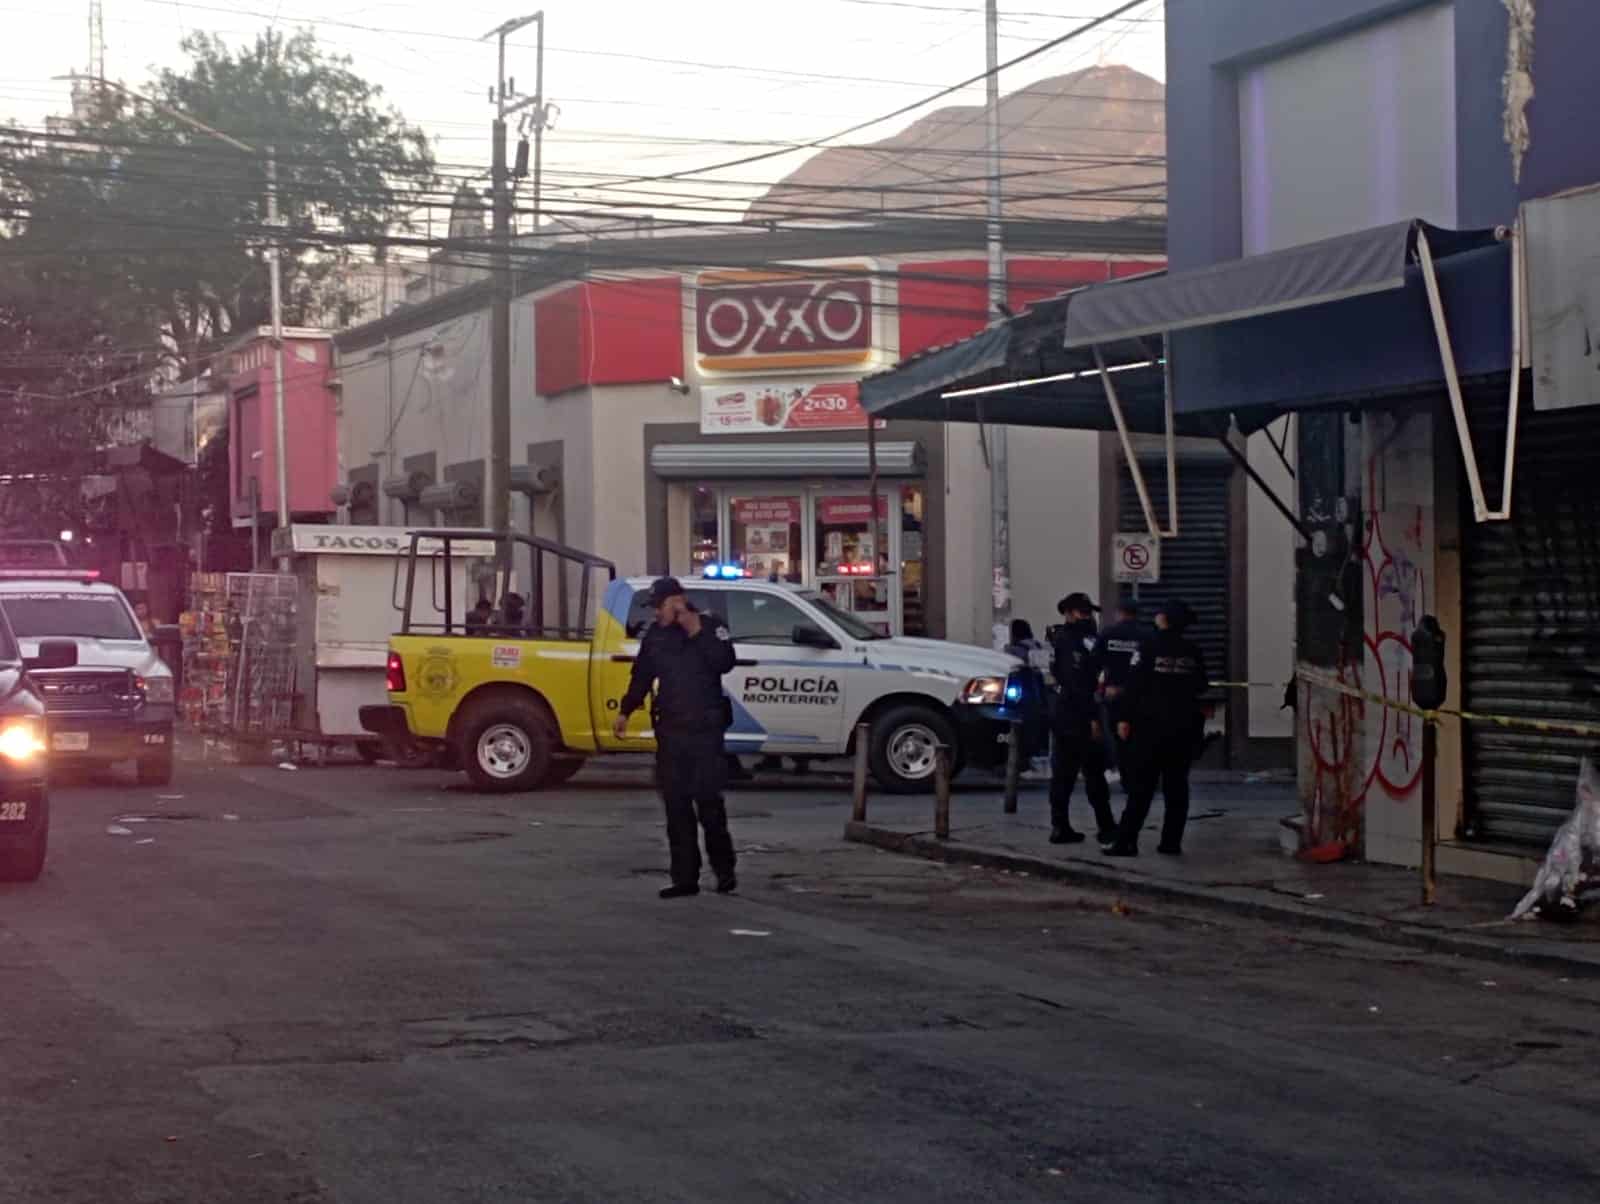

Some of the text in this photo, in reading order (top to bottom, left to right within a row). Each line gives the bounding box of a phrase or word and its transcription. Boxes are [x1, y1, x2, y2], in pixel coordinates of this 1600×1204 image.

[705, 282, 863, 354] OXXO
[313, 535, 399, 550] TACOS
[743, 675, 840, 694] POLICÍA
[742, 692, 840, 706] MONTERREY
